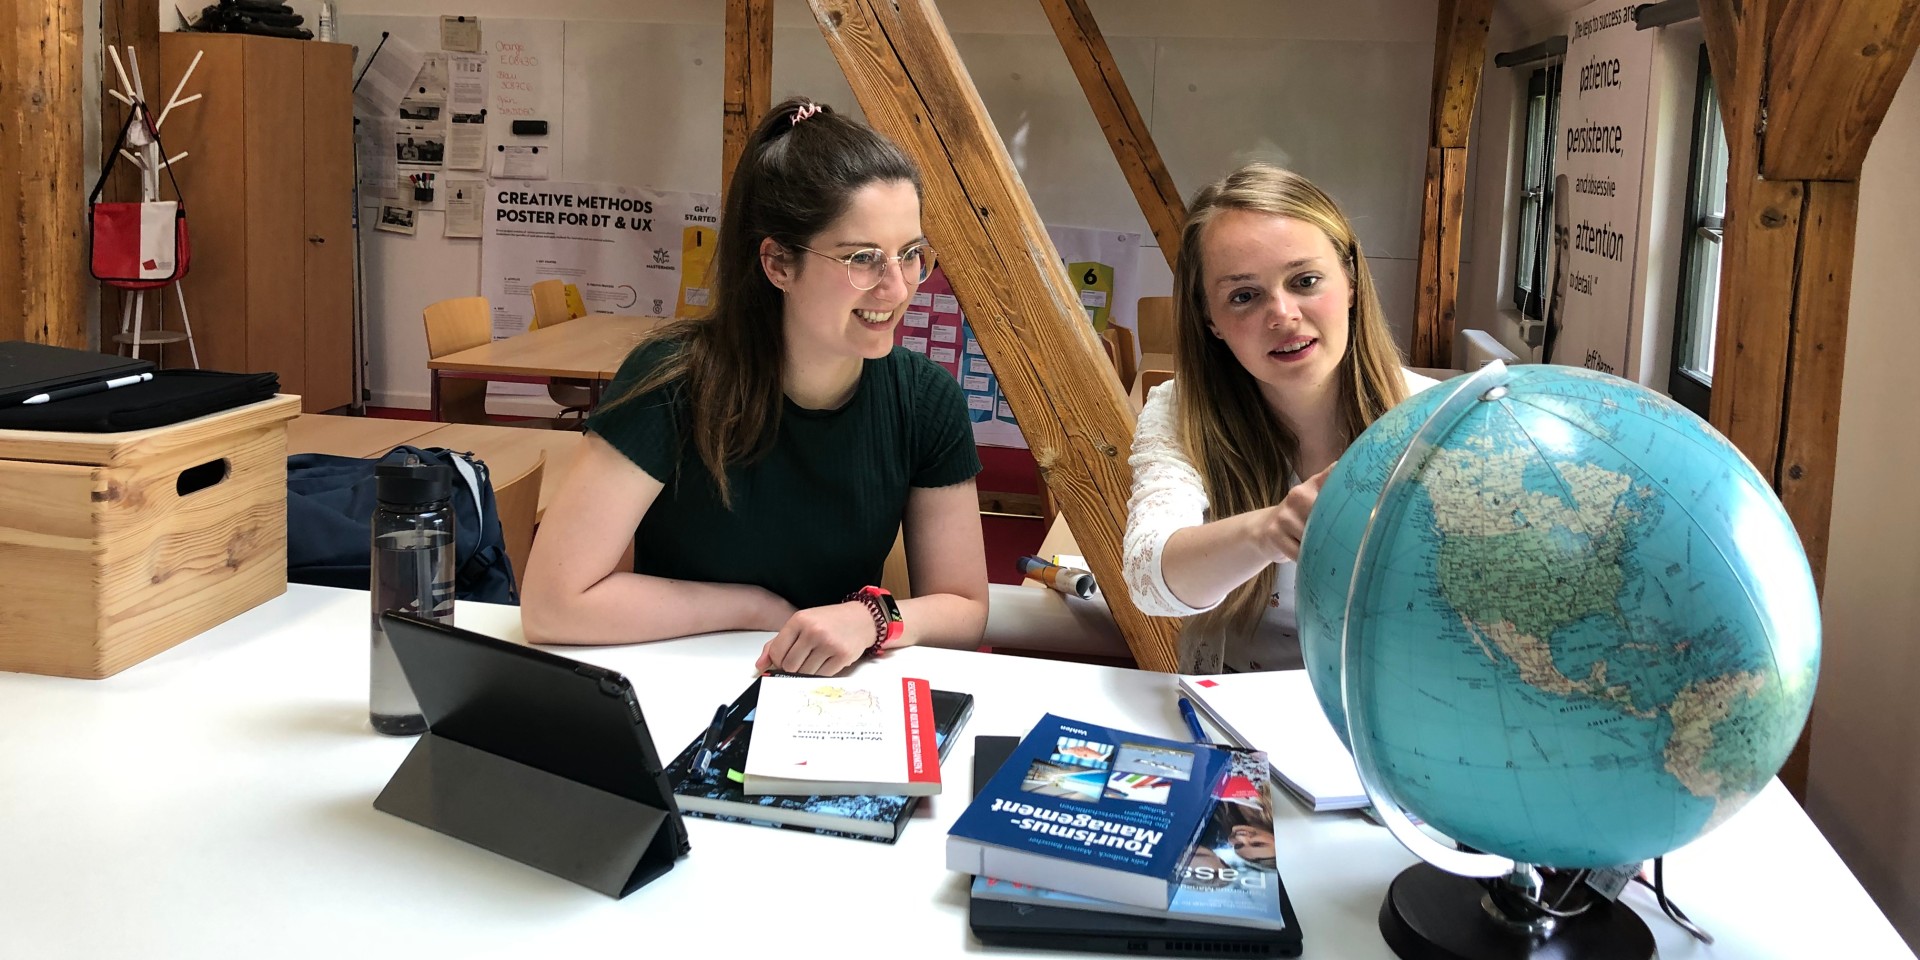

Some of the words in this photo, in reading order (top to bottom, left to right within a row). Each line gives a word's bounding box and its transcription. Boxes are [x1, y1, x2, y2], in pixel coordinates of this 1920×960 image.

[1600, 9, 1622, 30] success
[1624, 4, 1636, 23] are
[1579, 54, 1622, 100] patience,
[1567, 118, 1624, 160] persistence,
[1588, 174, 1616, 198] obsessive
[497, 191, 573, 208] CREATIVE
[576, 196, 653, 214] METHODS
[496, 208, 555, 224] POSTER
[558, 212, 588, 226] FOR
[592, 214, 610, 228] DT
[614, 216, 626, 230] &
[630, 218, 652, 232] UX
[684, 214, 717, 223] STARTED
[1576, 219, 1624, 262] attention
[1083, 268, 1098, 285] 6
[1060, 724, 1088, 736] Vahlen
[1124, 809, 1171, 824] Grundlagen
[1138, 804, 1168, 815] Auflage
[990, 798, 1164, 845] Management
[1154, 821, 1169, 830] Die
[1010, 818, 1154, 858] Tourismus-
[1064, 845, 1092, 856] Marion
[1130, 857, 1148, 866] Felix
